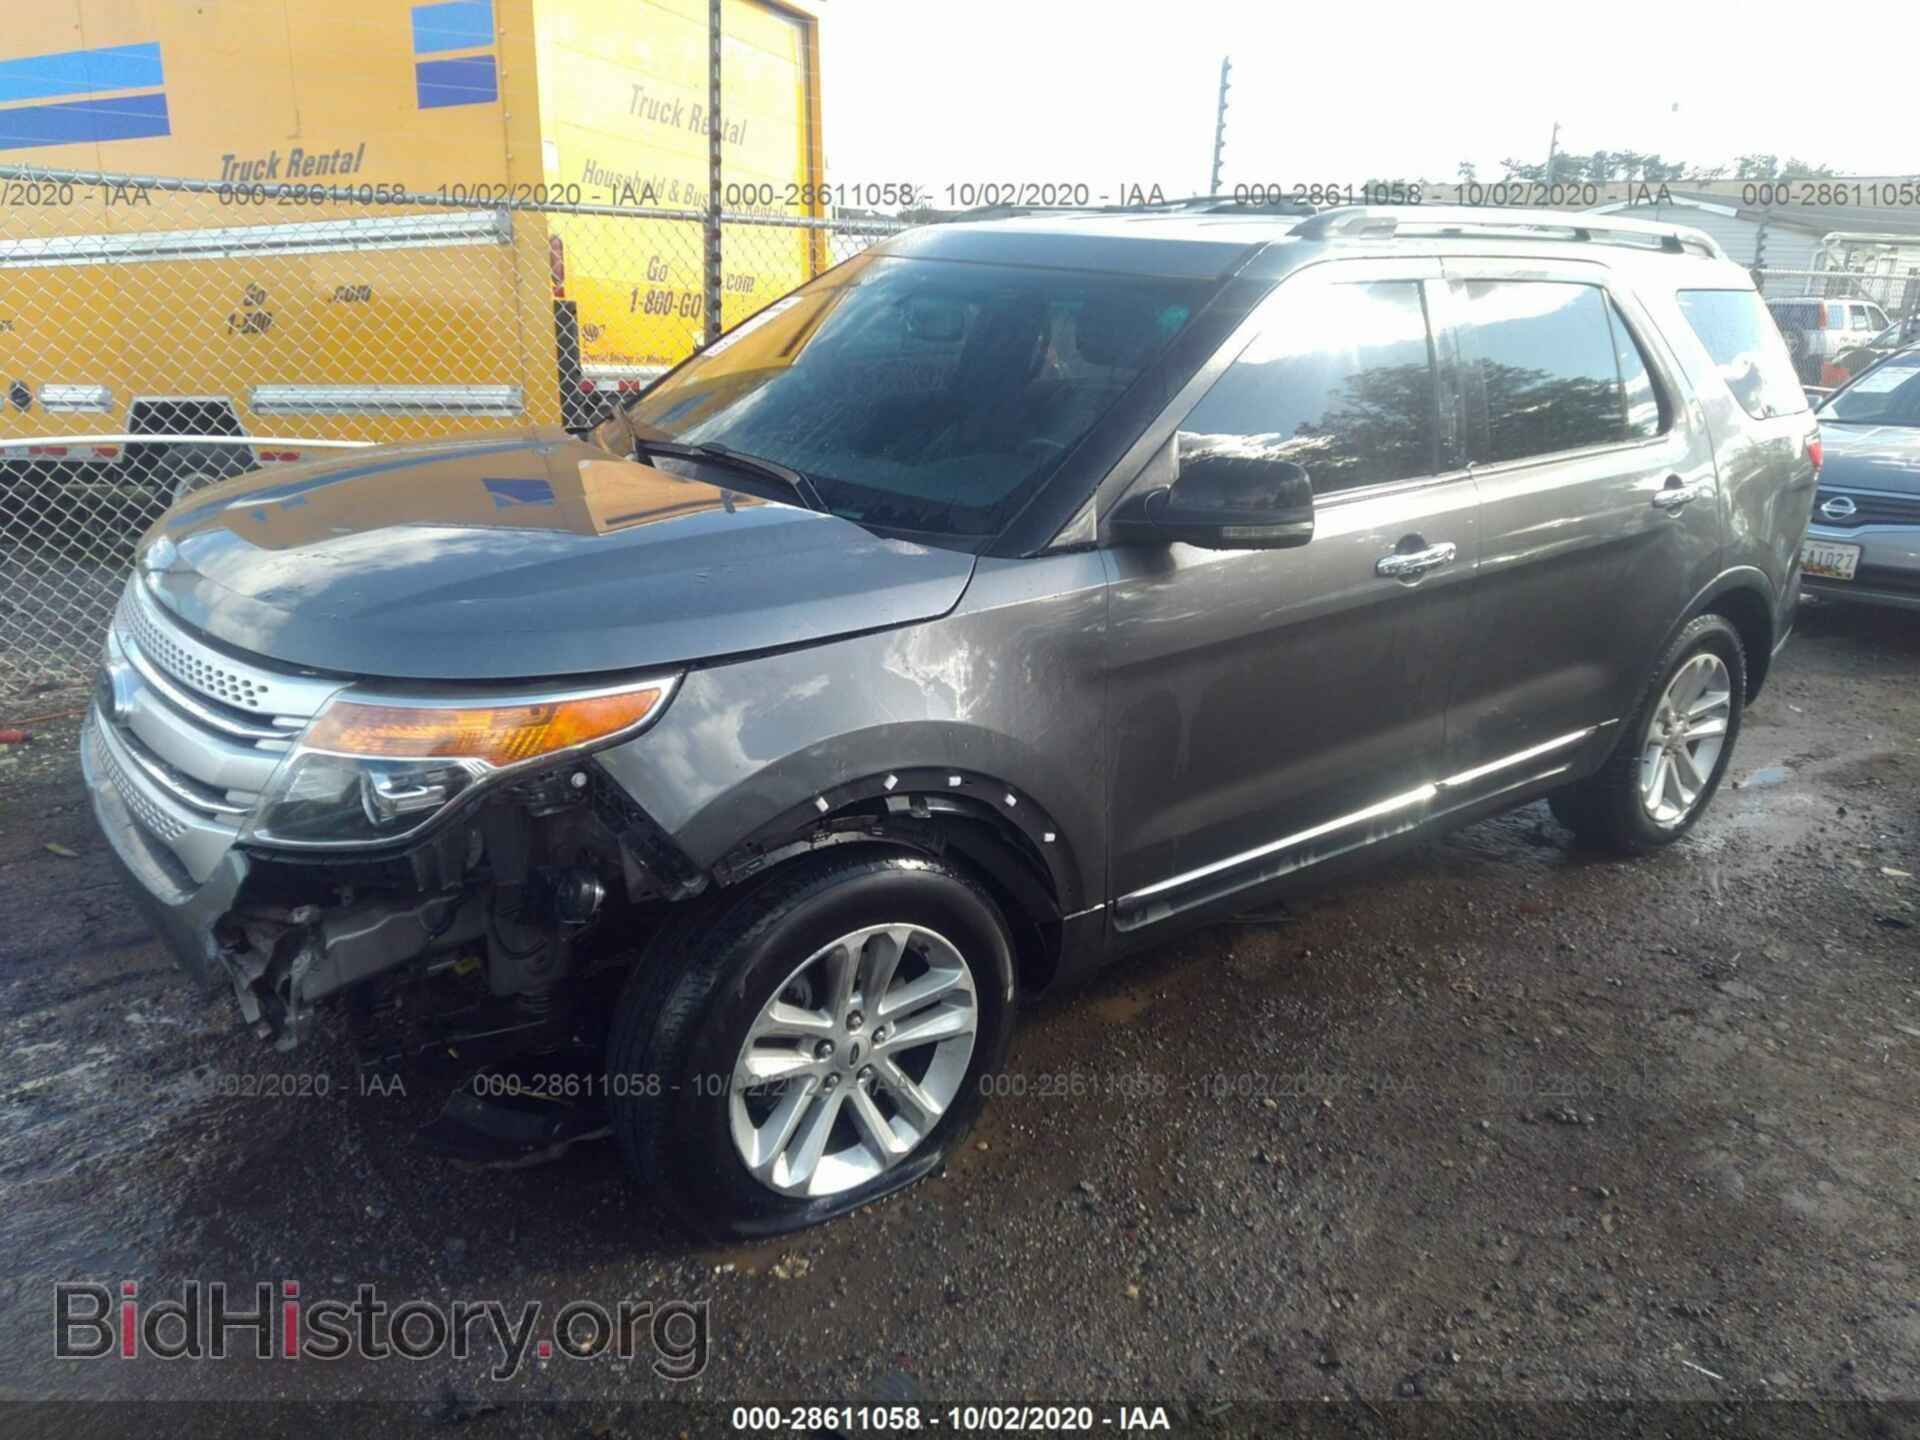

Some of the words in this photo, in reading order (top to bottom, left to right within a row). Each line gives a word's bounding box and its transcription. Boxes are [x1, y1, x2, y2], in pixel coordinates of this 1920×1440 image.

[630, 83, 684, 129] Truck
[688, 103, 748, 146] Retal
[221, 153, 281, 182] Truck
[286, 142, 365, 178] Rental
[647, 255, 668, 282] Go
